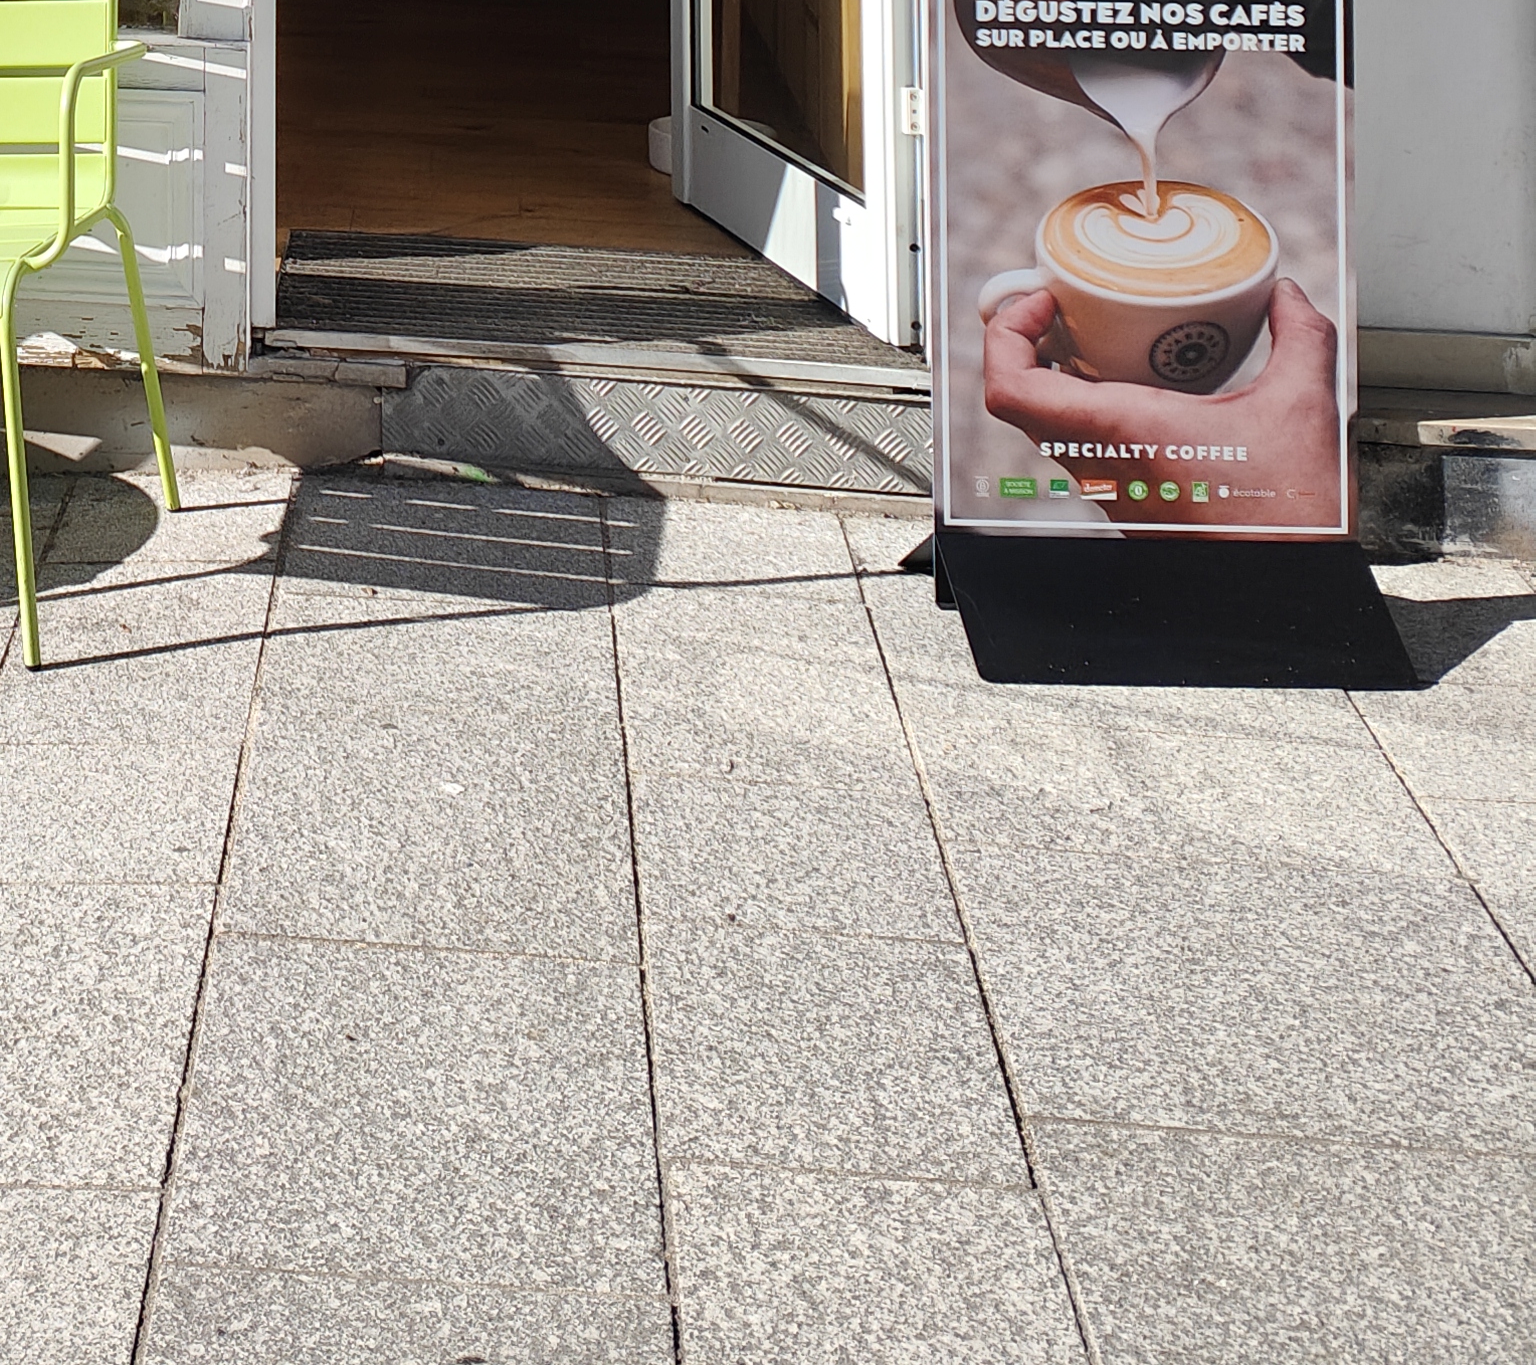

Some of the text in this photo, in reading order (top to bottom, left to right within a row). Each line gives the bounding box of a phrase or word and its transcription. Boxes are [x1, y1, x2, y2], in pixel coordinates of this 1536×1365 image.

[1140, 2, 1206, 26] NOS
[1208, 1, 1306, 28] CAFÉS
[975, 29, 1306, 53] SUR PLACE OU À EMPORTER
[1039, 442, 1248, 461] SPECIALTY COFFEE
